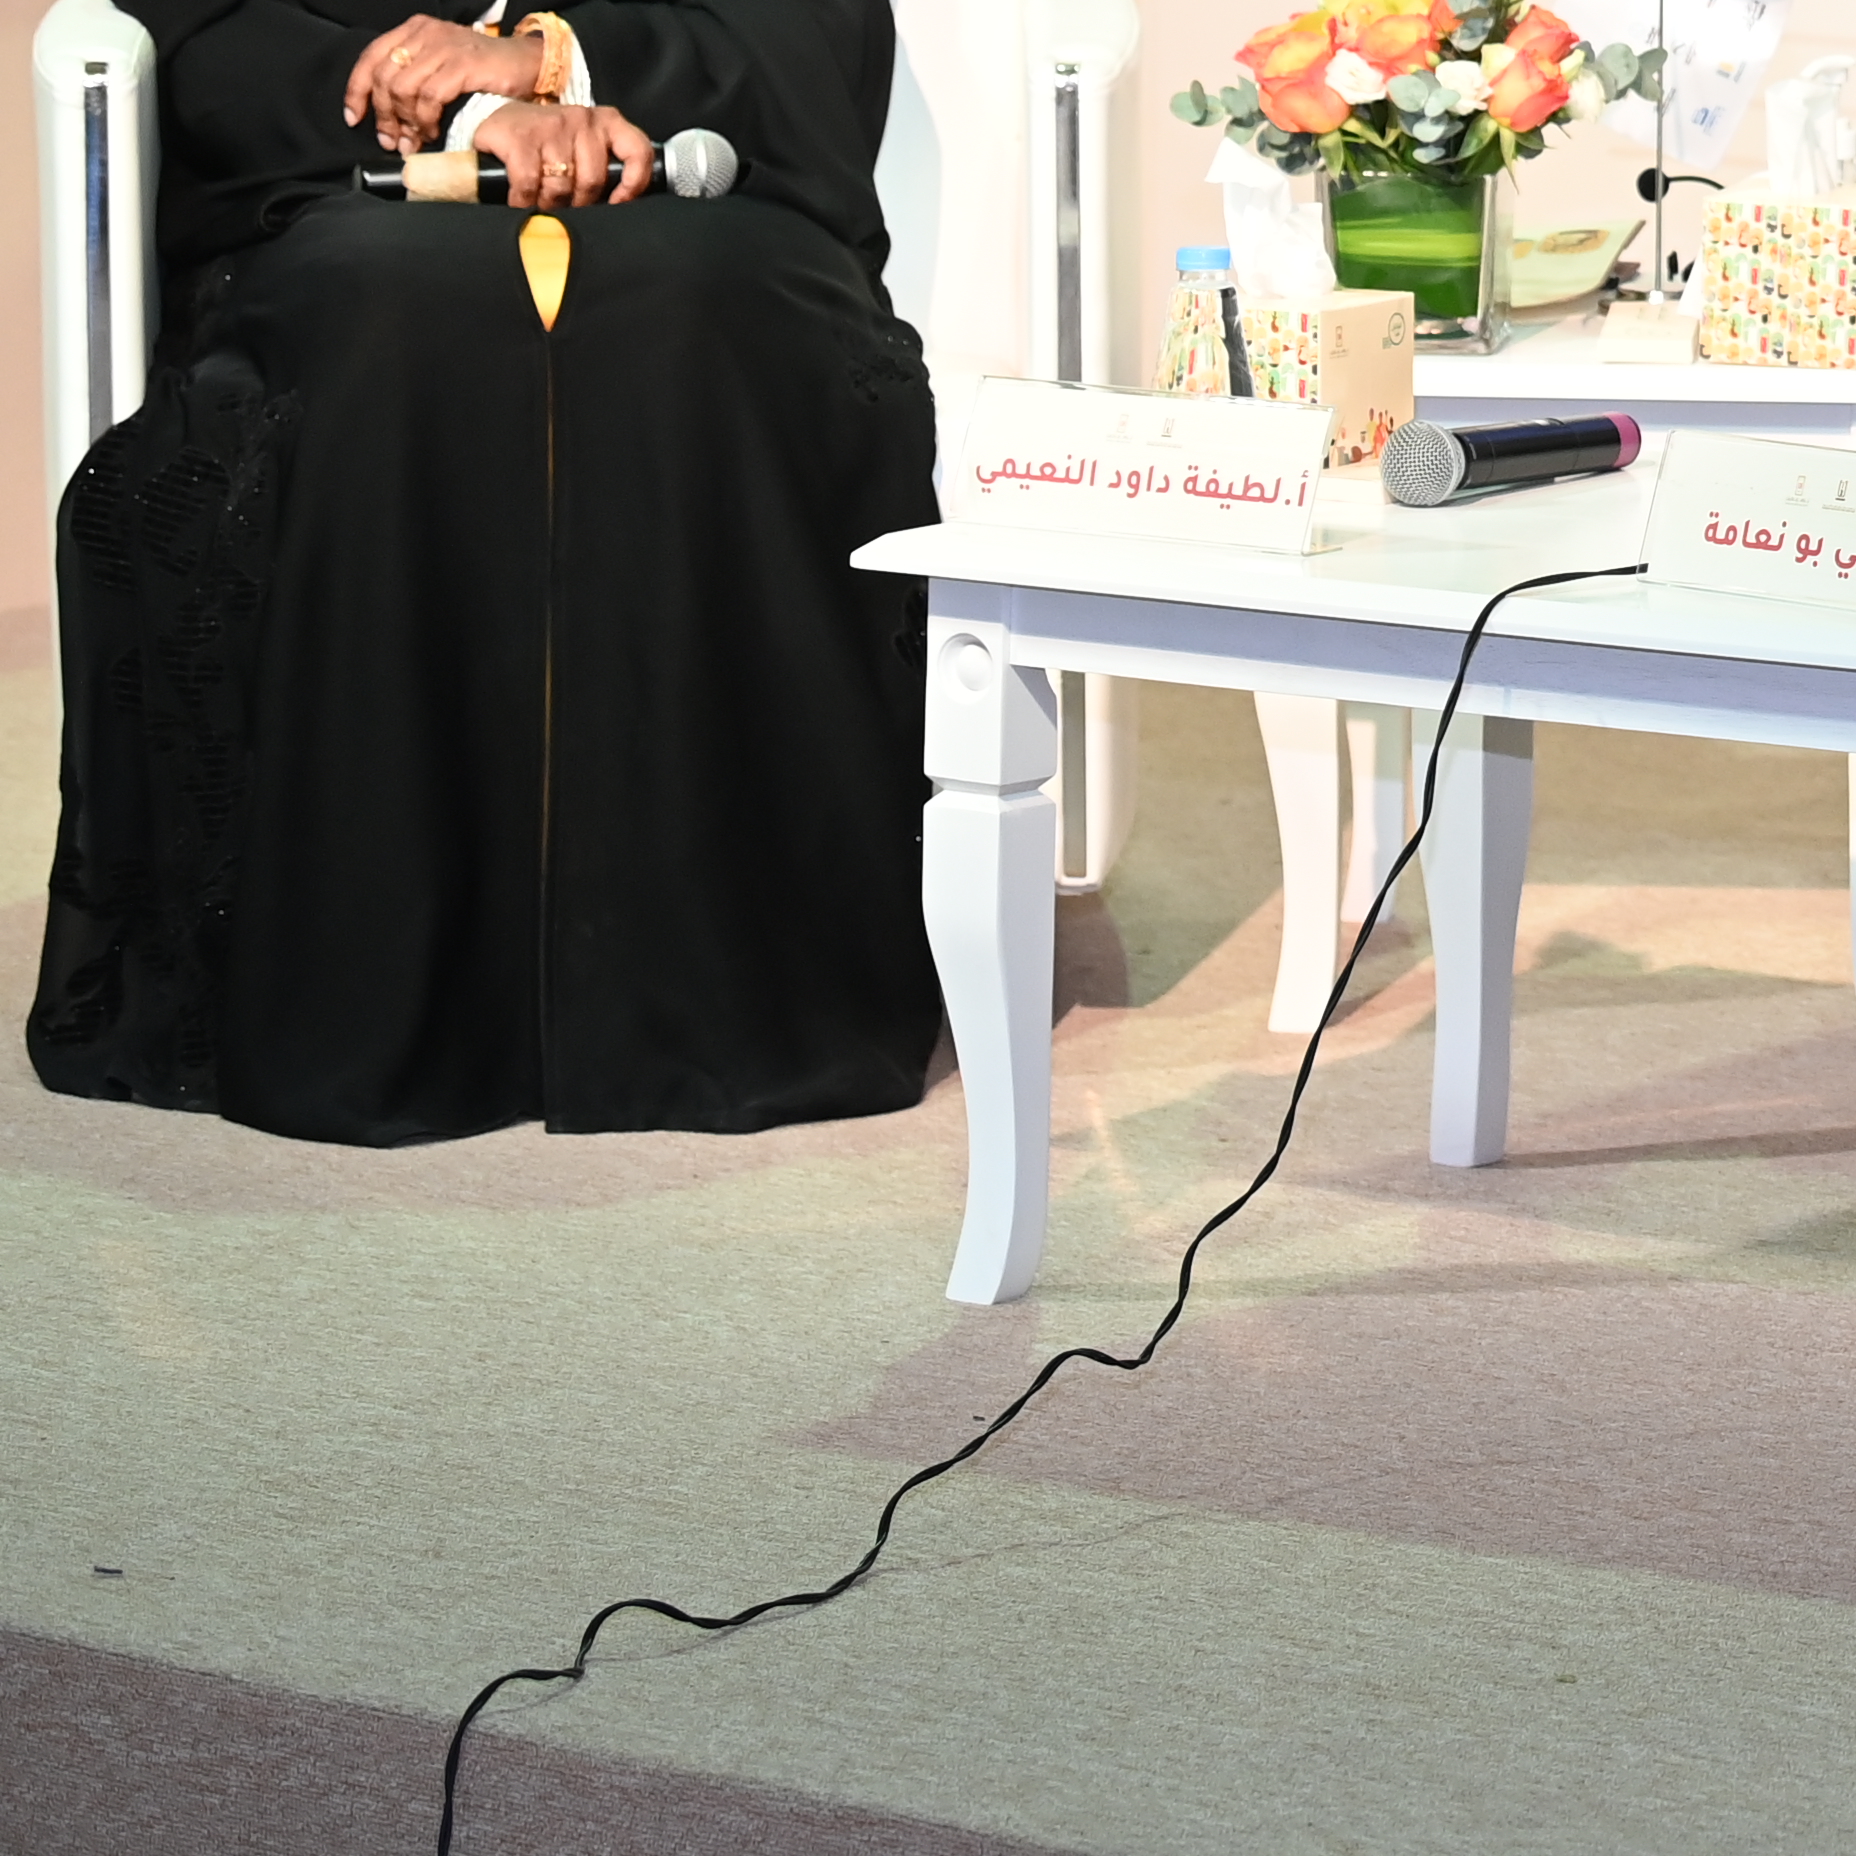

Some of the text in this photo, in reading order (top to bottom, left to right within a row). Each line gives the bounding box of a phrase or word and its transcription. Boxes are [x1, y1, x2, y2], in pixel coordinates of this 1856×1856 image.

[975, 453, 1098, 494] النعيمي
[1107, 464, 1171, 499] داود
[1703, 510, 1788, 553] نعامة
[1793, 532, 1824, 568] بو
